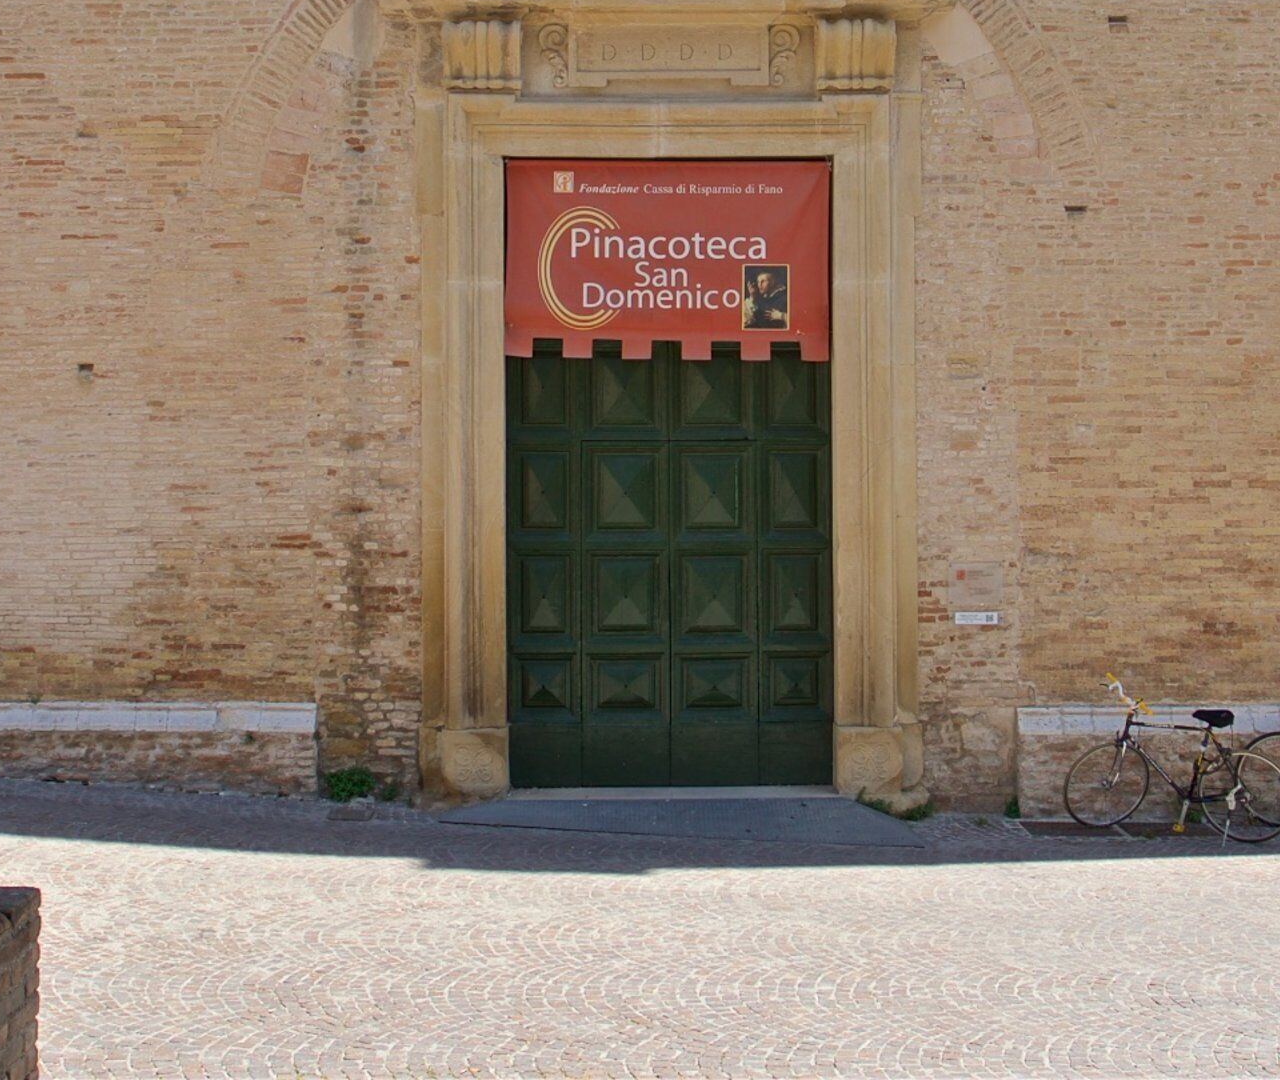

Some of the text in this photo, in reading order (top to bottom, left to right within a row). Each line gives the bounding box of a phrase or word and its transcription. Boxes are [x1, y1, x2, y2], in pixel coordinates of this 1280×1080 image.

[579, 183, 783, 196] Fondazione Cassa di Risparmio di Fano
[570, 227, 767, 260] Pinacoteca
[634, 261, 688, 288] San
[582, 282, 740, 310] Domenico
